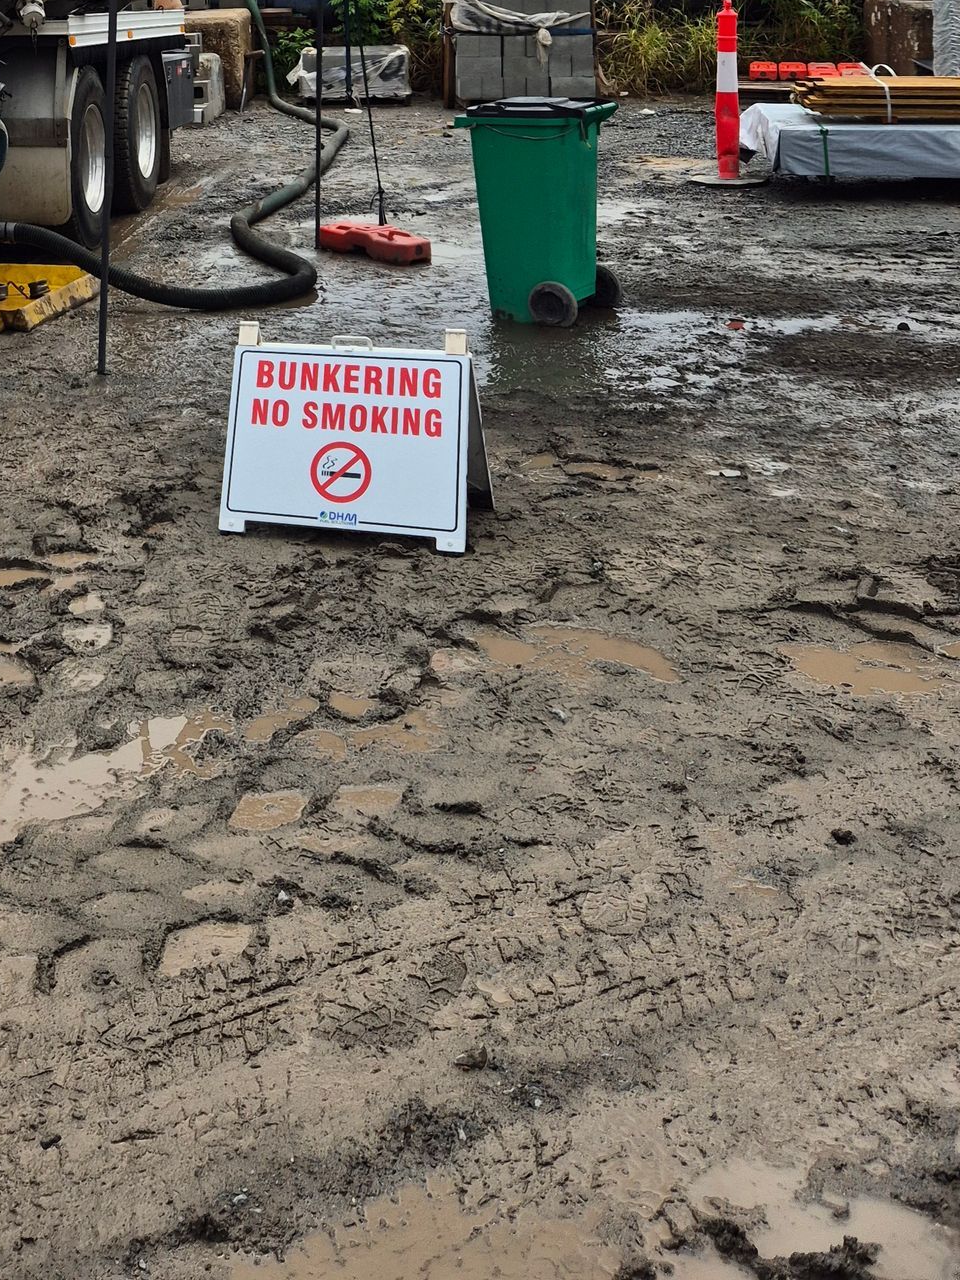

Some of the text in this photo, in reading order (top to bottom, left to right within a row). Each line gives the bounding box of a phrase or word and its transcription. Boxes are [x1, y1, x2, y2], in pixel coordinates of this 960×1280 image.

[256, 360, 442, 399] BUNKERING
[251, 398, 442, 437] NO SMOKING
[329, 511, 357, 526] DHM
